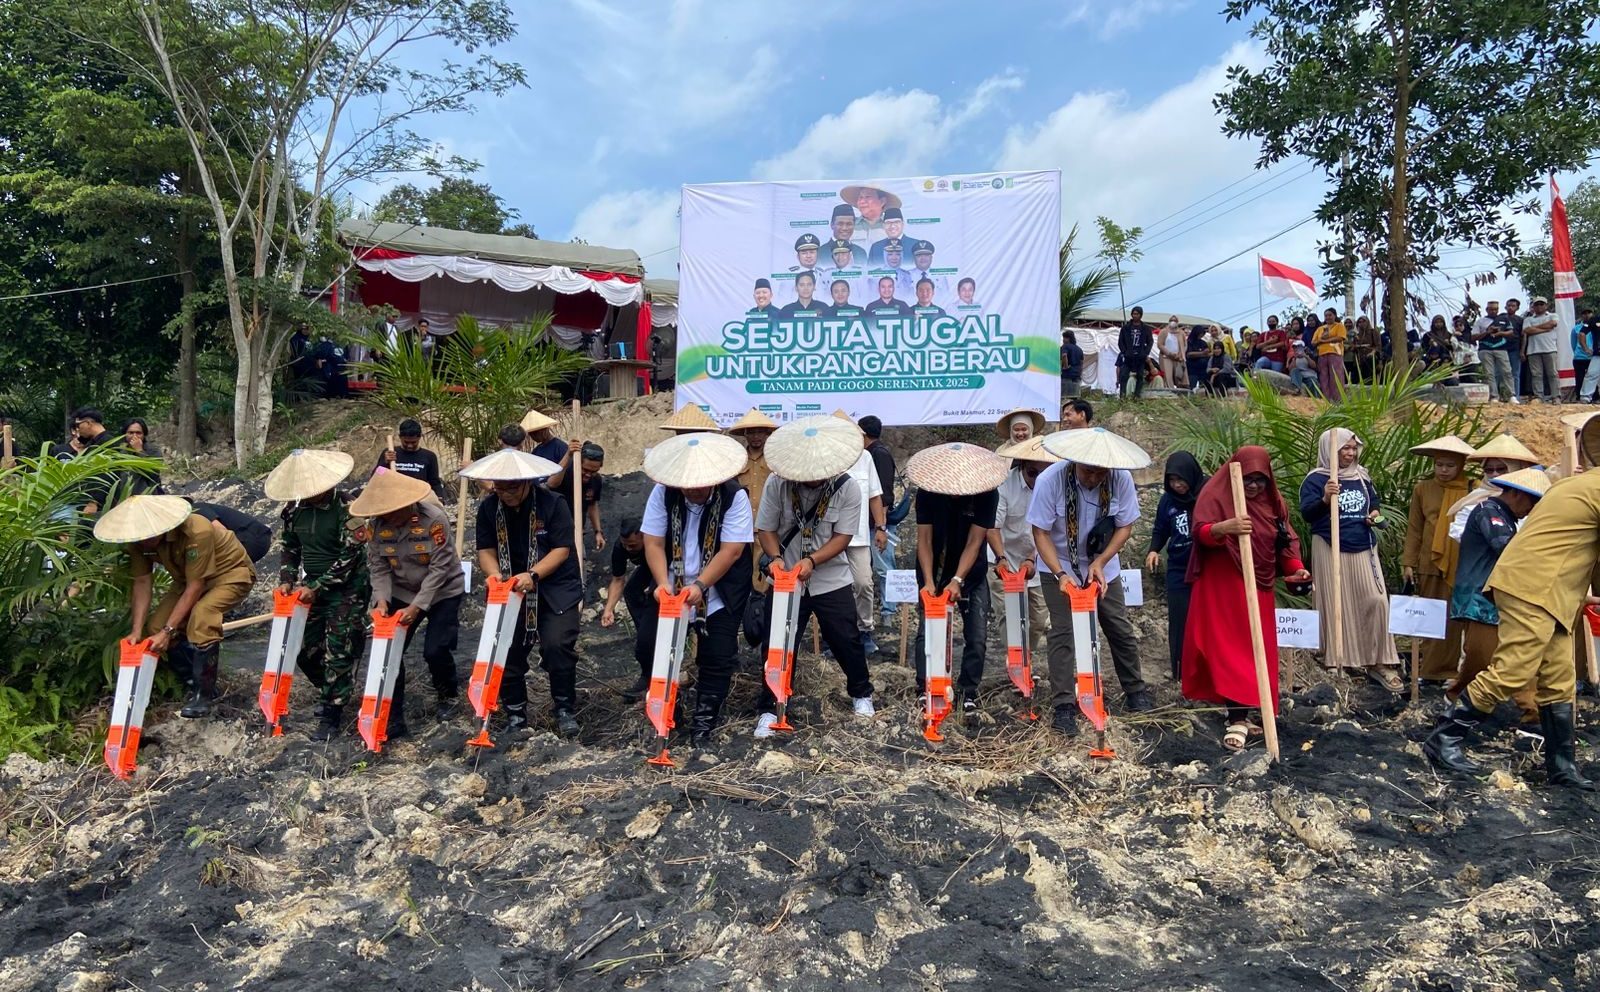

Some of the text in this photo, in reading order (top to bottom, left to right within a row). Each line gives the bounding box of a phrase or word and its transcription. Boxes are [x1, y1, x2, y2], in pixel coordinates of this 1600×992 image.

[722, 315, 1011, 351] SEJUTA TUGAL
[706, 348, 1027, 377] UNTUK PANGAN BERAU
[761, 377, 969, 391] TANAM PADI GOGO SERENTAK 2025
[943, 409, 960, 417] Bukit
[960, 408, 986, 416] Makmur,
[1278, 616, 1298, 624] DPP
[1275, 626, 1303, 635] GAPKI
